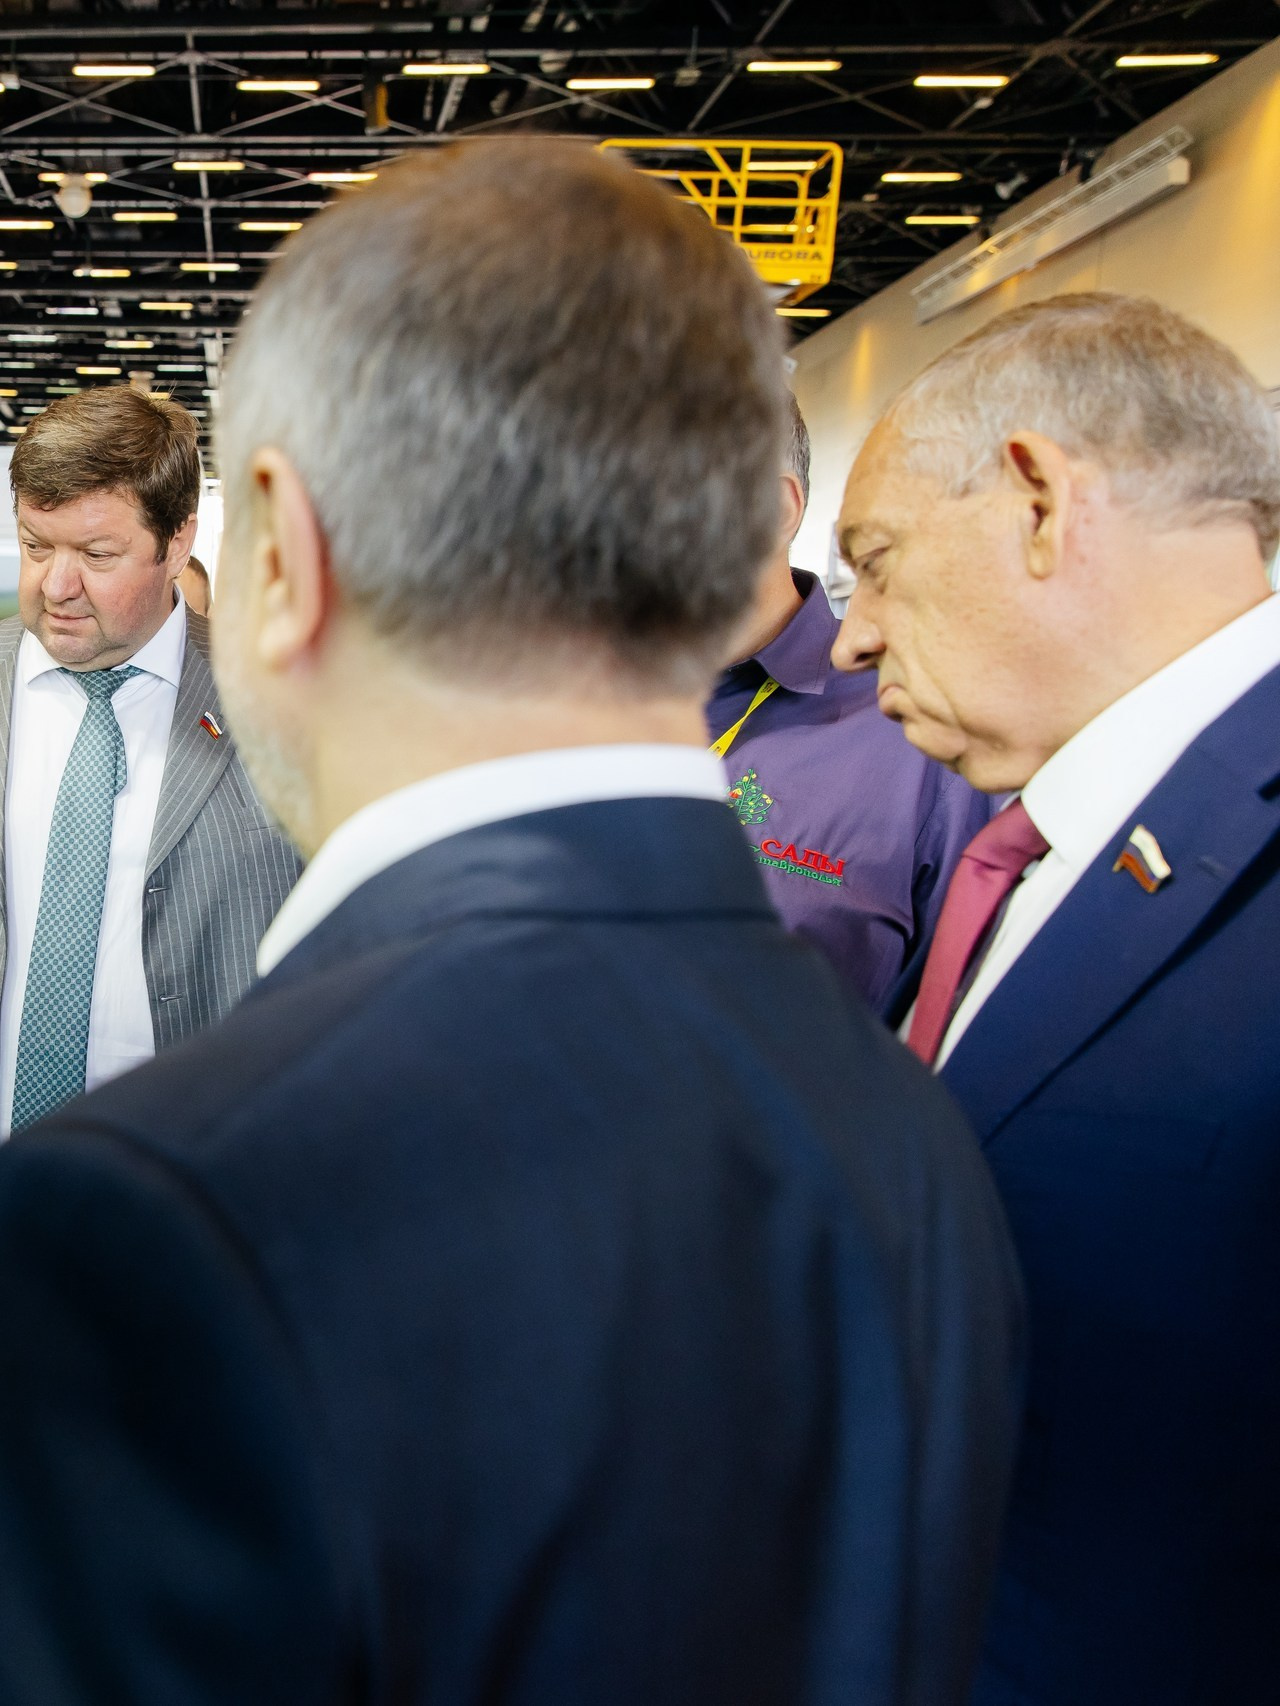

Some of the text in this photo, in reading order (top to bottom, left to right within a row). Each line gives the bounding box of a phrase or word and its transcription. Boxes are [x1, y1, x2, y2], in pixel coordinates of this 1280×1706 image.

[748, 249, 823, 261] URORA
[755, 856, 842, 887] таврополья
[761, 839, 845, 877] САДЫ
